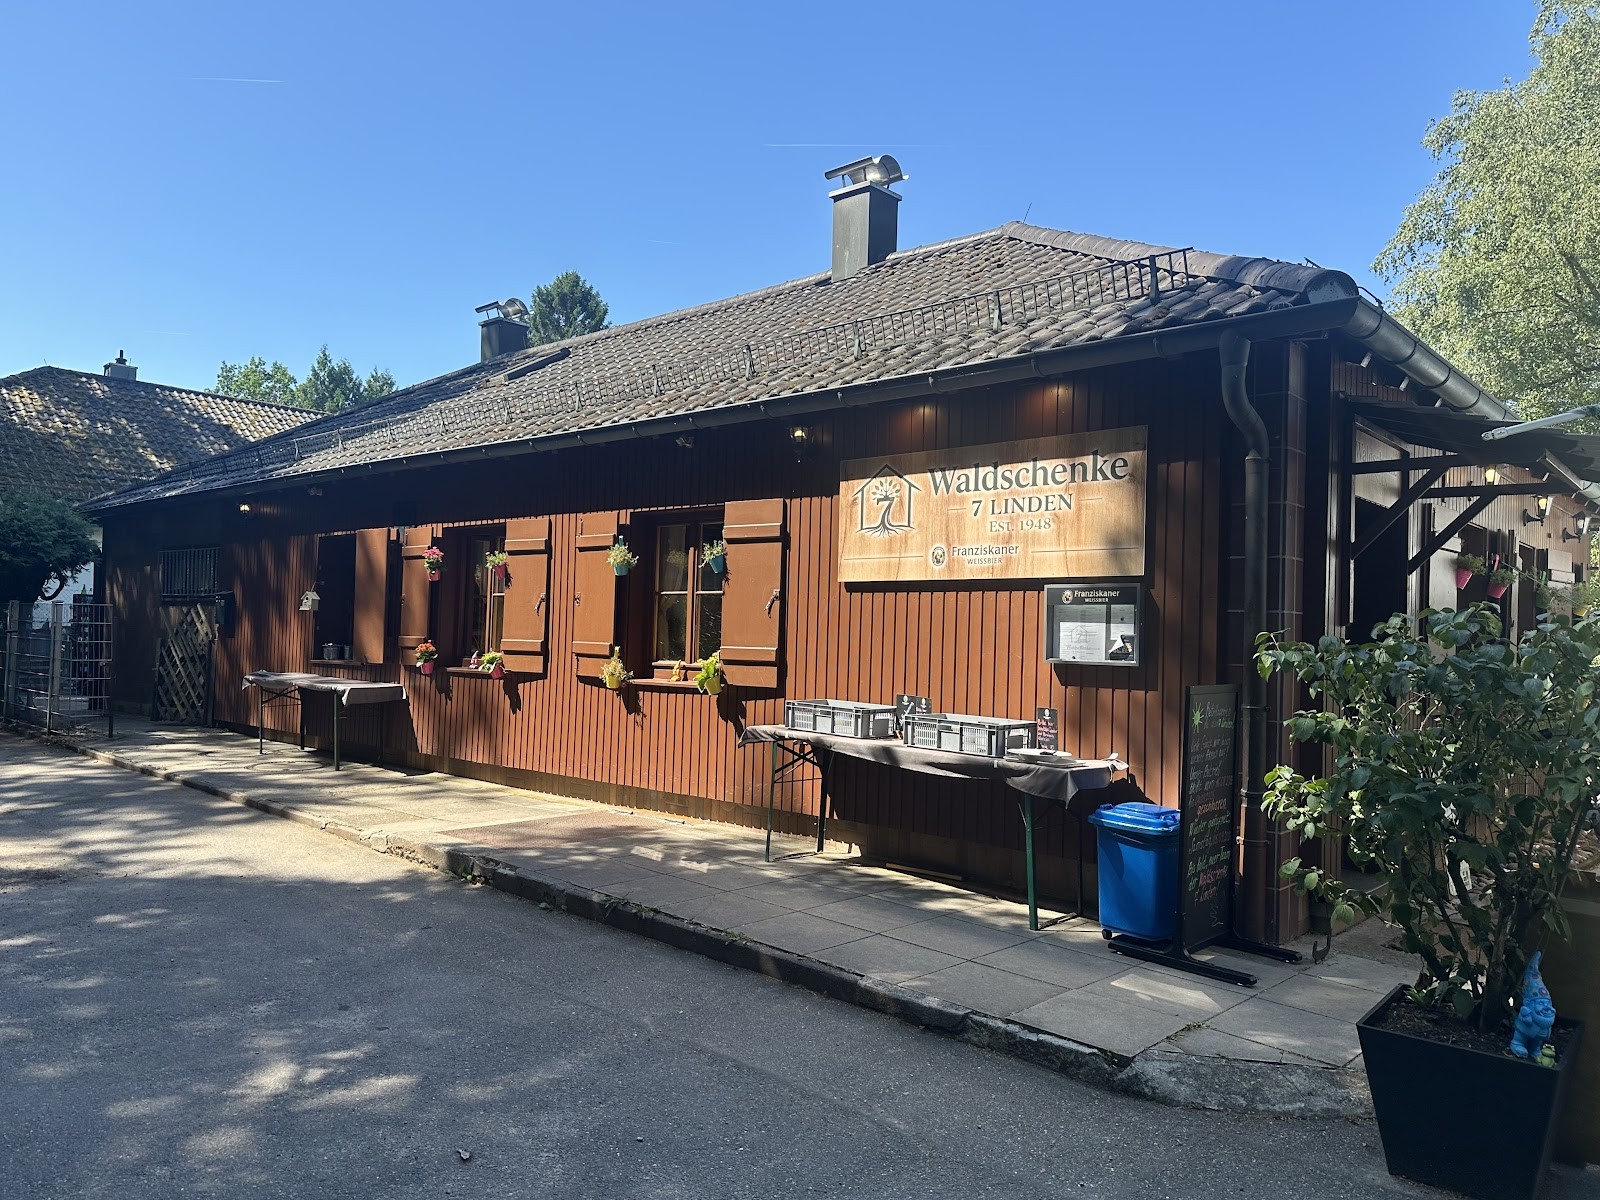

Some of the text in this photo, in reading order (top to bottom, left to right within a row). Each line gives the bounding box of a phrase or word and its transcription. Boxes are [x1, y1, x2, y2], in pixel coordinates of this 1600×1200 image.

[928, 450, 1129, 496] Waldschenke
[972, 494, 1073, 517] 7 LINDEN
[1020, 518, 1051, 531] 1948
[952, 545, 1019, 556] Franziskaner
[1074, 590, 1120, 598] Franziskaner
